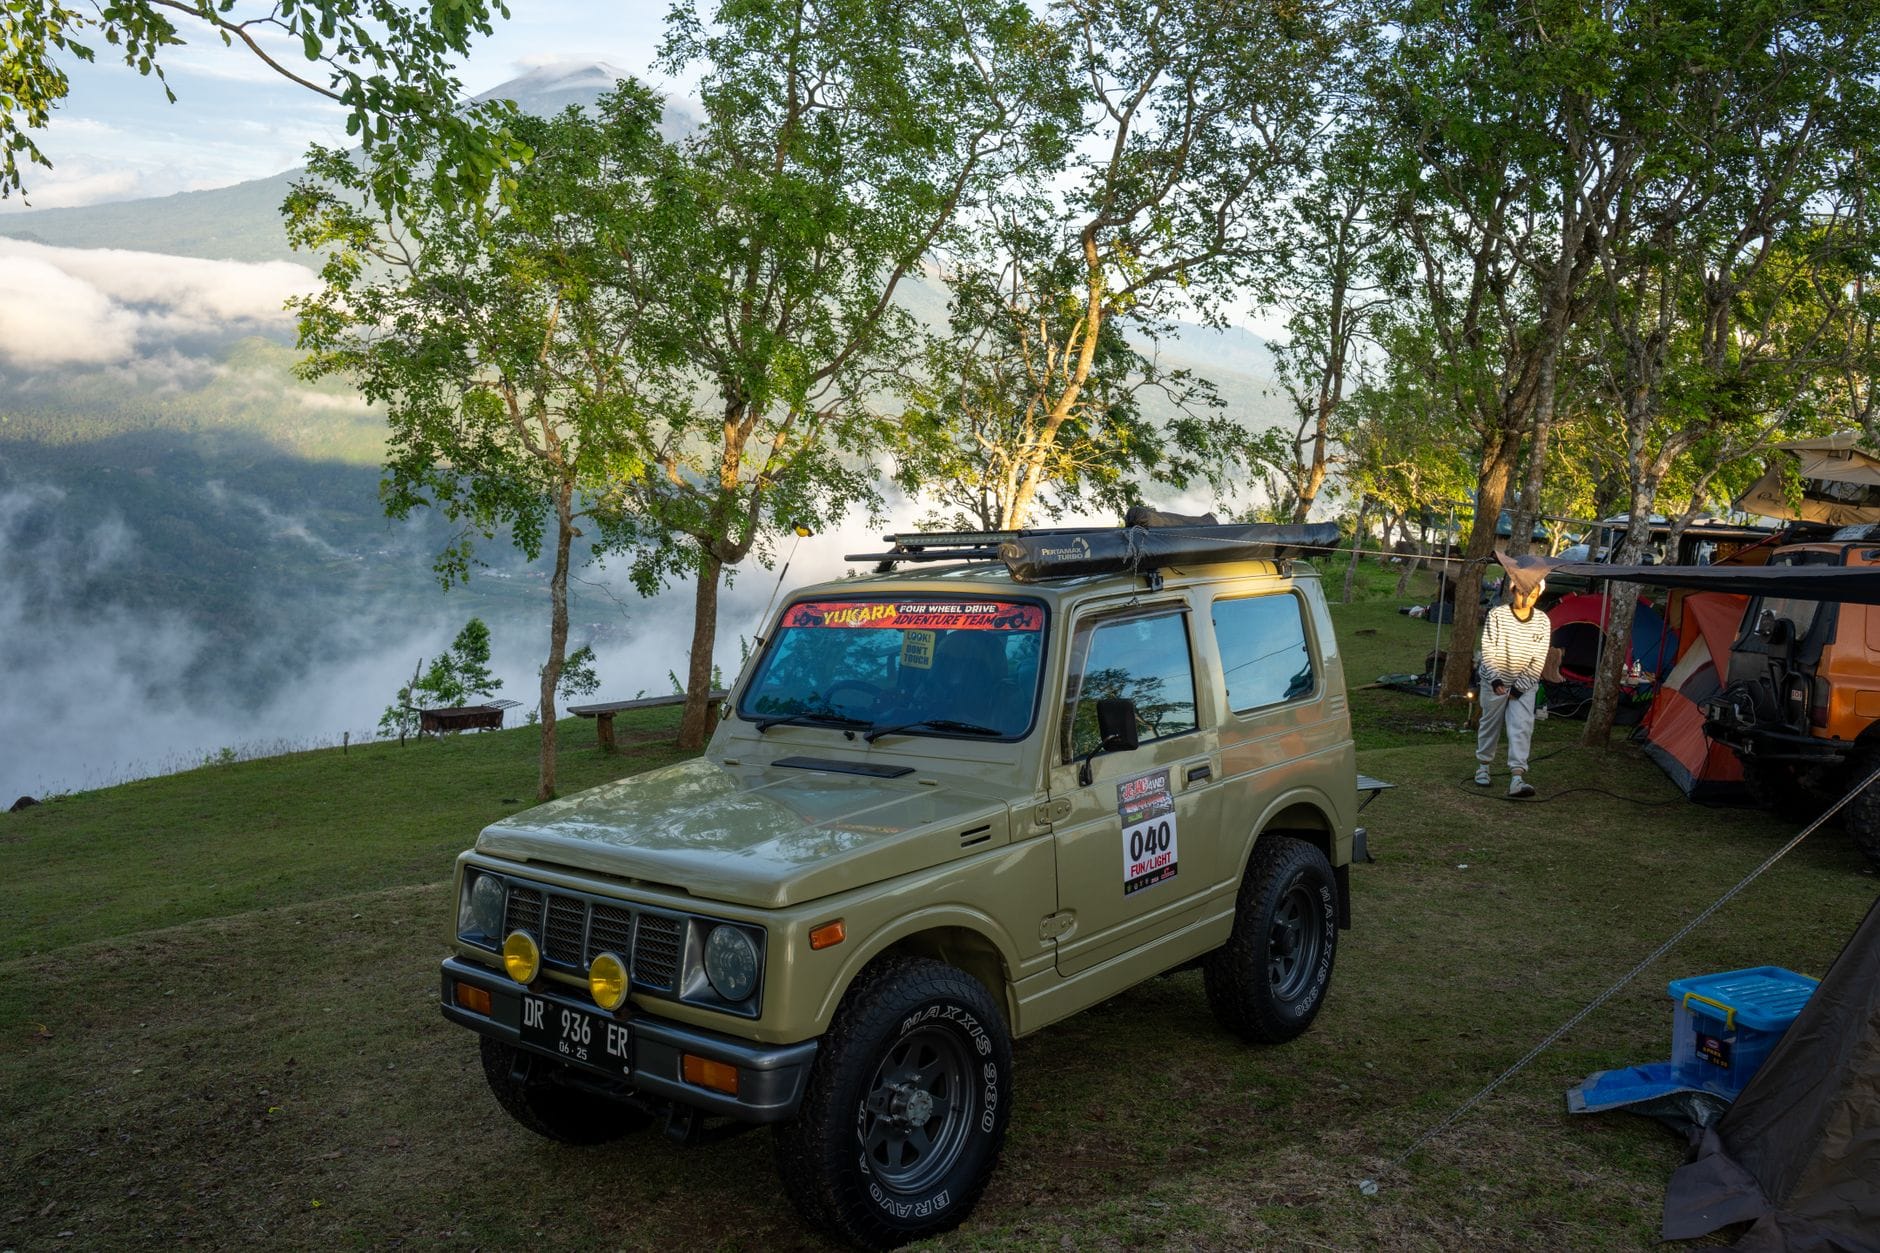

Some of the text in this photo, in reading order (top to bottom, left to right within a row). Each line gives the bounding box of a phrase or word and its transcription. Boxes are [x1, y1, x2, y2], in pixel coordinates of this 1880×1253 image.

[1041, 547, 1081, 556] PERTAMAX
[824, 604, 897, 625] YUKARA
[893, 614, 995, 625] ADVENTURE TEAM
[899, 605, 997, 613] FOUR WHEEL DRIVE
[904, 653, 929, 665] TOUCH
[1130, 821, 1170, 862] 040
[1131, 852, 1171, 877] FUN/LIGHT
[523, 997, 628, 1059] DR 936 ER
[901, 1005, 997, 1133] MAXXIS 980
[870, 1182, 950, 1218] BRAVO
